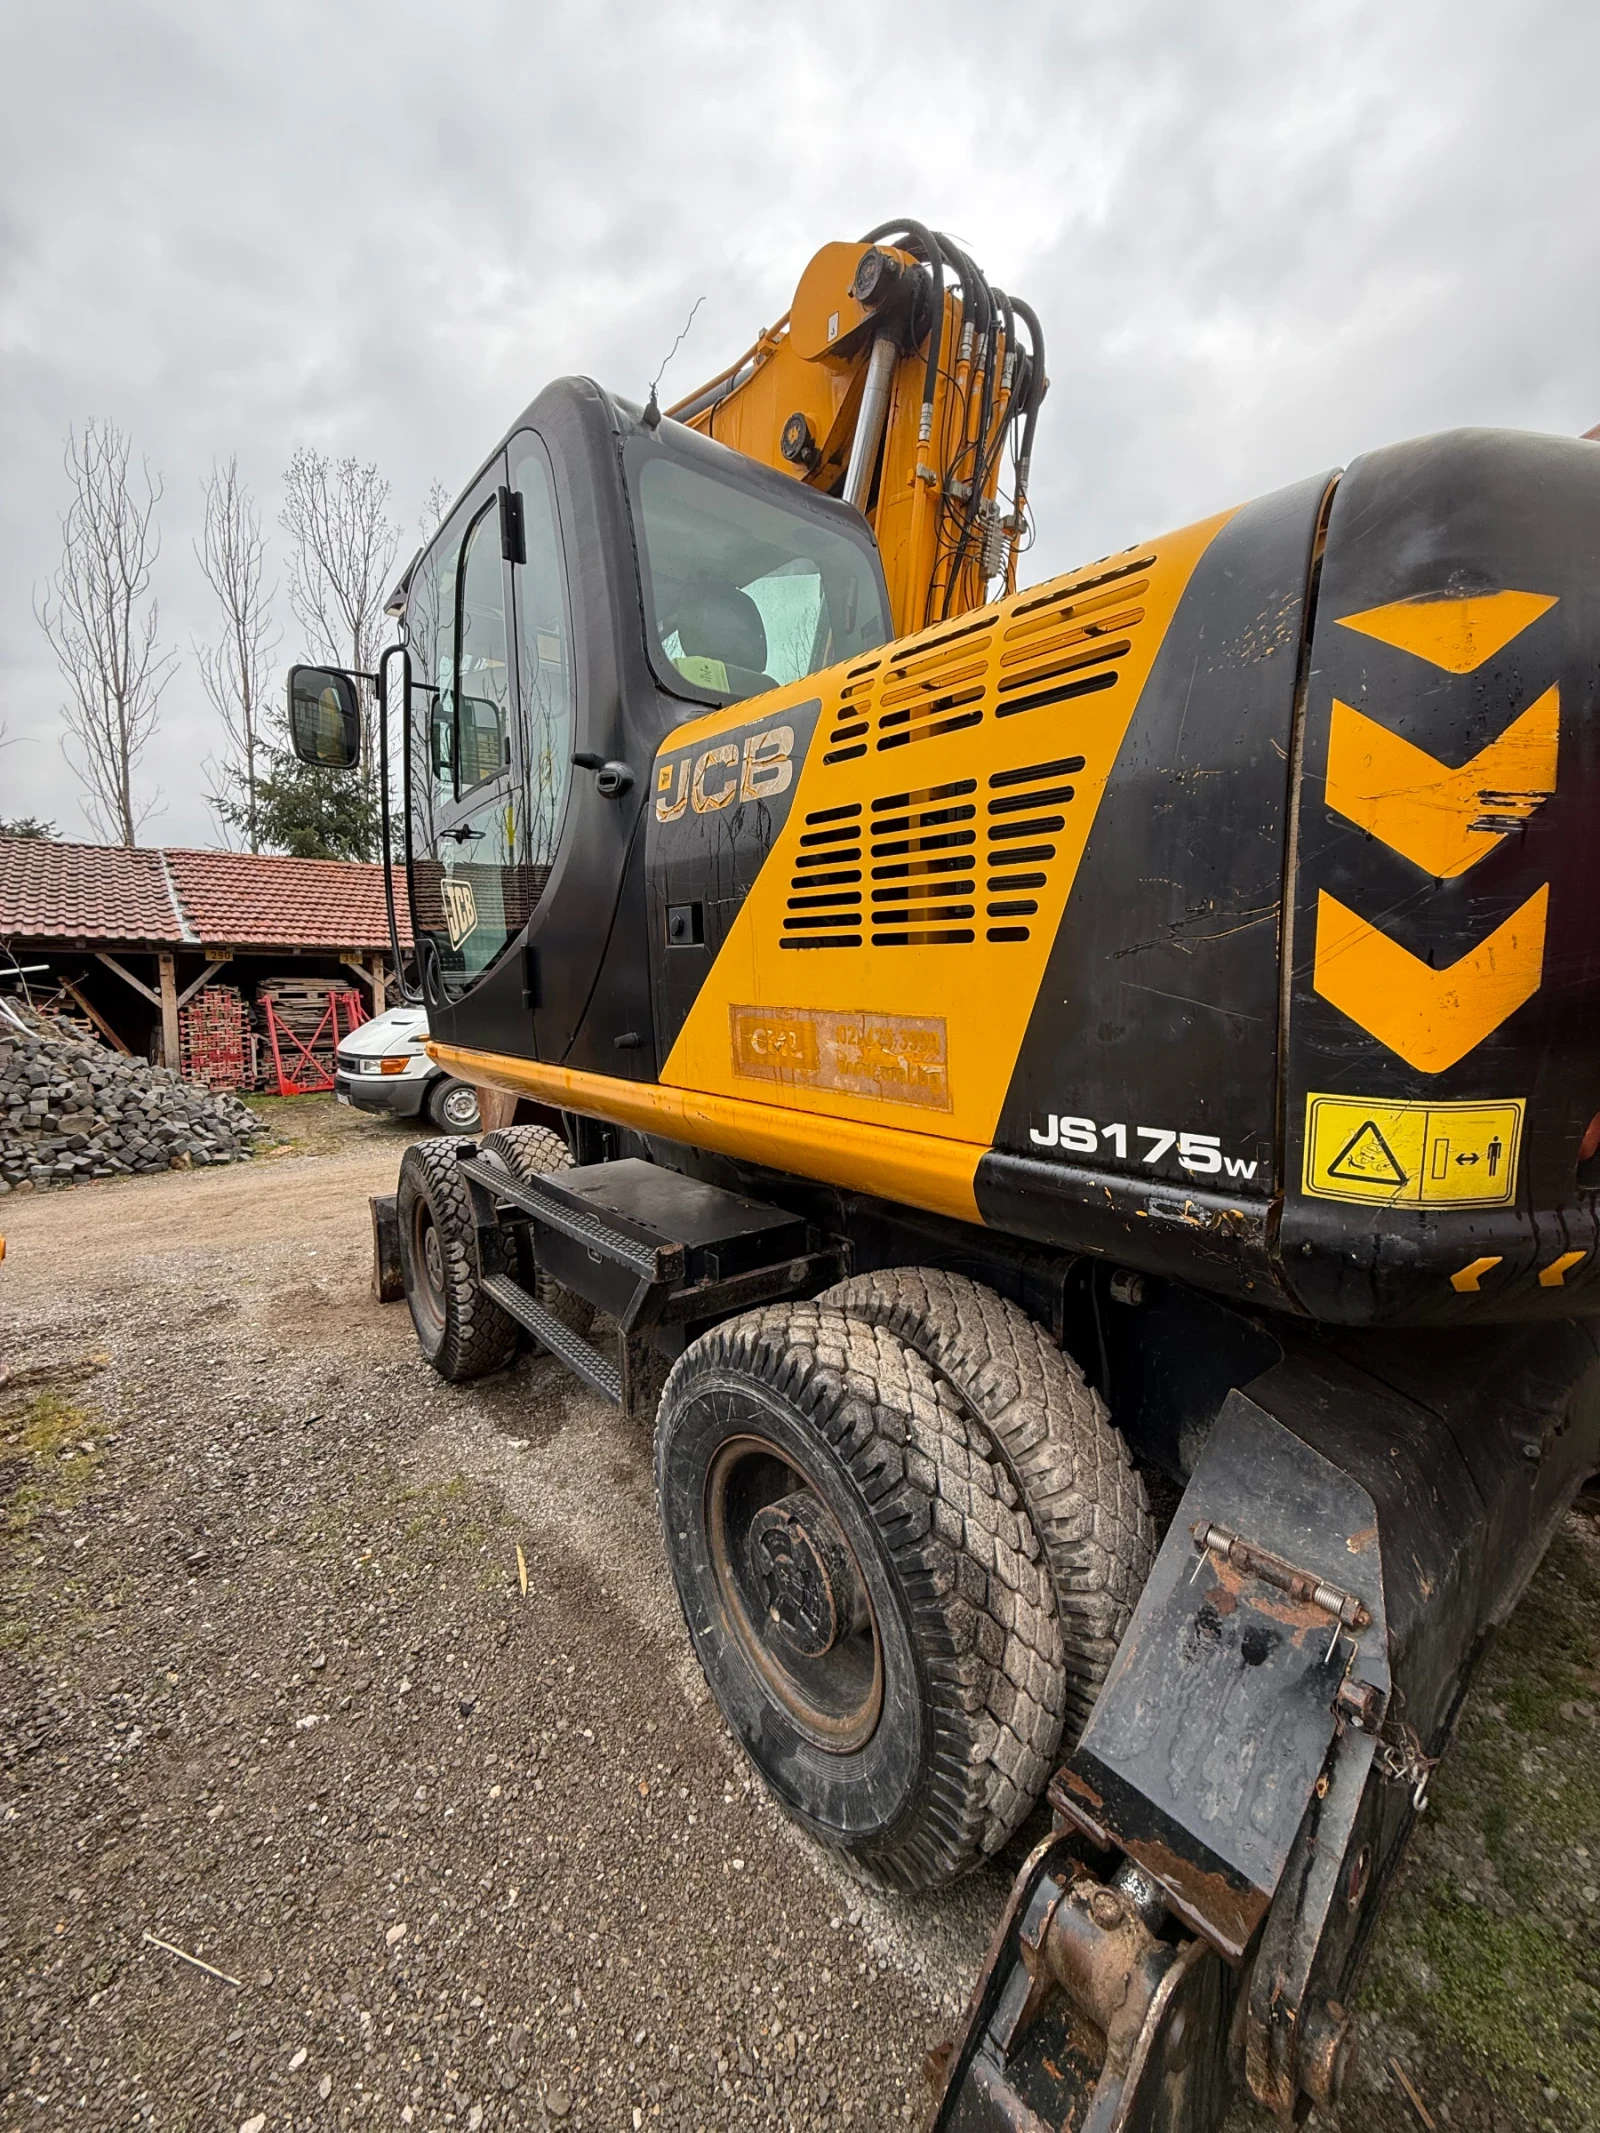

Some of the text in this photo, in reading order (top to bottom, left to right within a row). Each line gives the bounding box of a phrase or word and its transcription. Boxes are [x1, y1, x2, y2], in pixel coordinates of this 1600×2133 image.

[656, 726, 794, 823] JCB
[447, 886, 475, 941] JCB
[211, 951, 230, 959] 290
